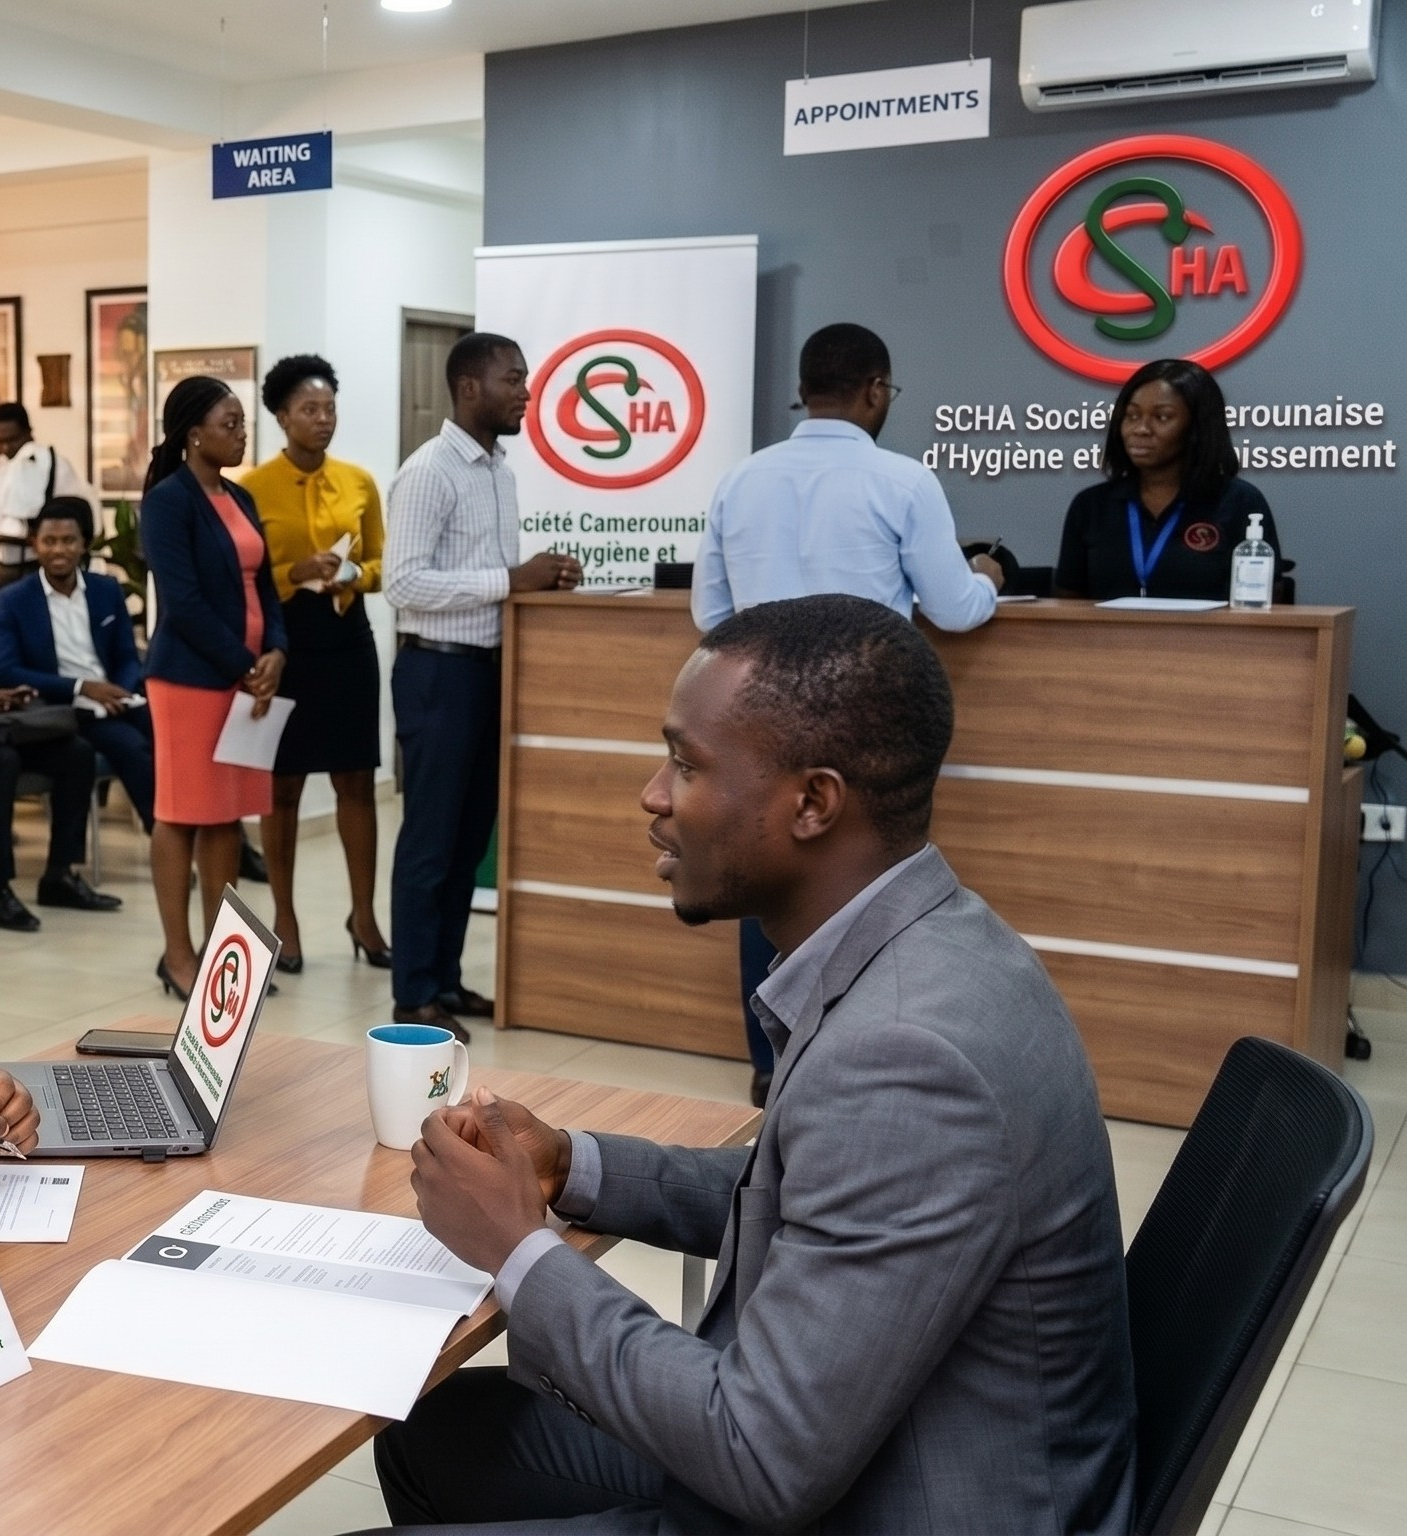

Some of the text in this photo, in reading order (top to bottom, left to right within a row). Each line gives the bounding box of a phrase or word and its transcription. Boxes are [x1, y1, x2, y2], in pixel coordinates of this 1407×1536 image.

[793, 88, 980, 127] APPOINTMENTS
[233, 143, 311, 168] WAITING
[248, 167, 296, 188] AREA
[935, 403, 1015, 431] SCHA
[1025, 401, 1114, 431] Socié
[1073, 443, 1101, 469] et
[579, 511, 706, 533] Camerounai
[657, 542, 677, 563] et
